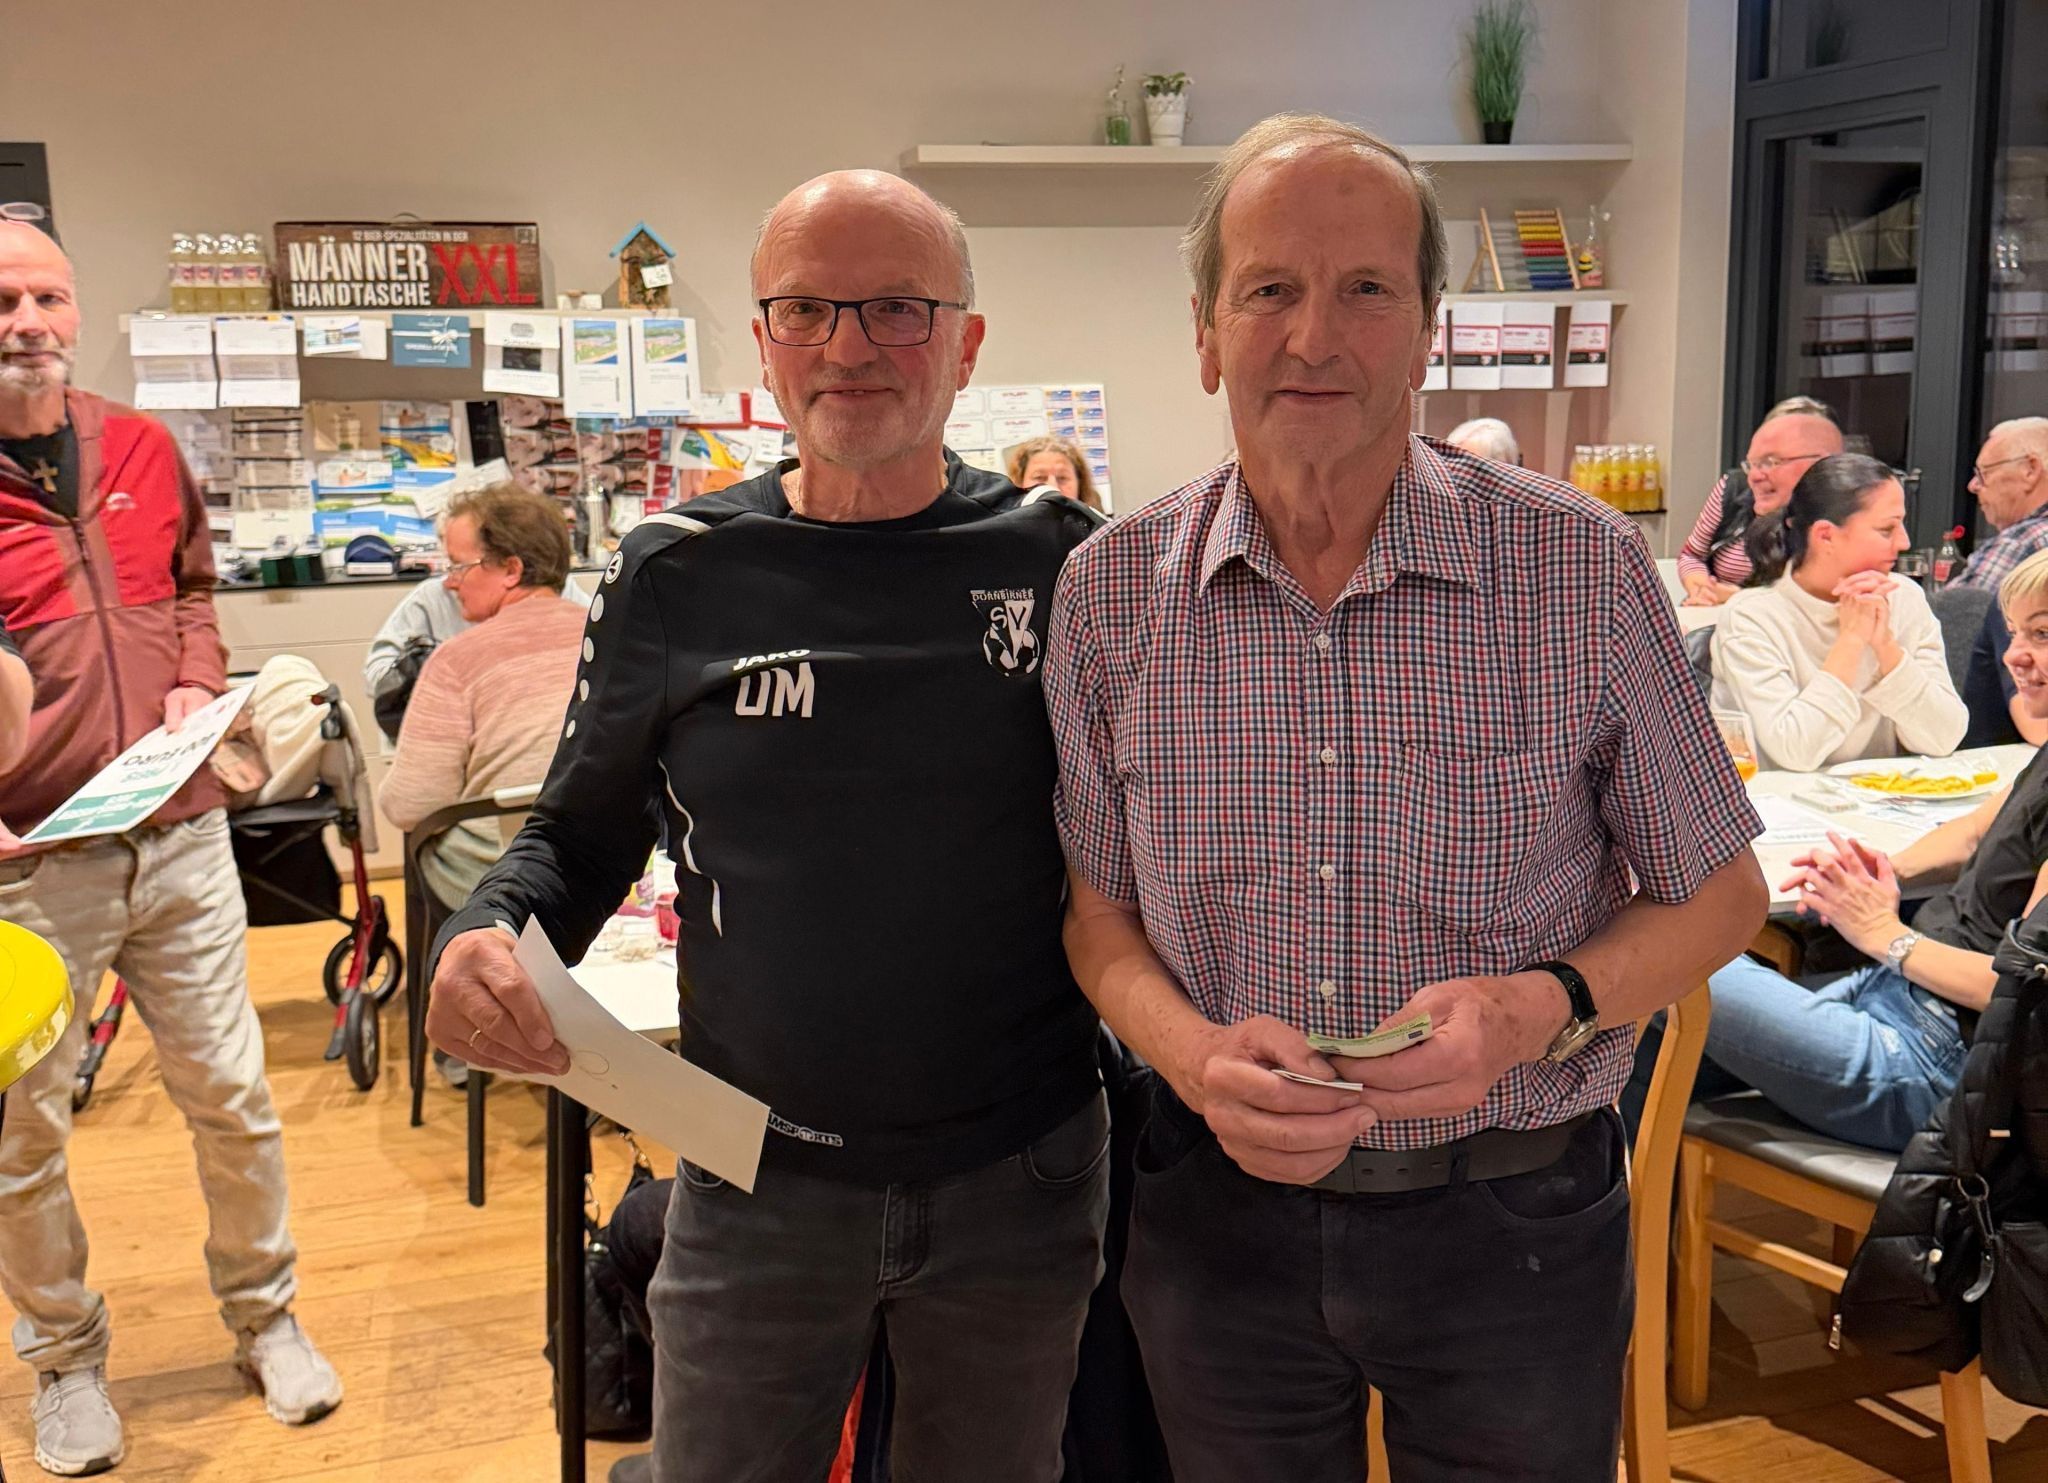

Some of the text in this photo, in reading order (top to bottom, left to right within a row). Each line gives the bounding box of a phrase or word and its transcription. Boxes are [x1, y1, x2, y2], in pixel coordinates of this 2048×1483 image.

[288, 235, 430, 282] MÄNNER
[432, 243, 537, 305] XXL
[291, 281, 431, 307] HANDTASCHE
[990, 606, 1027, 630] SV
